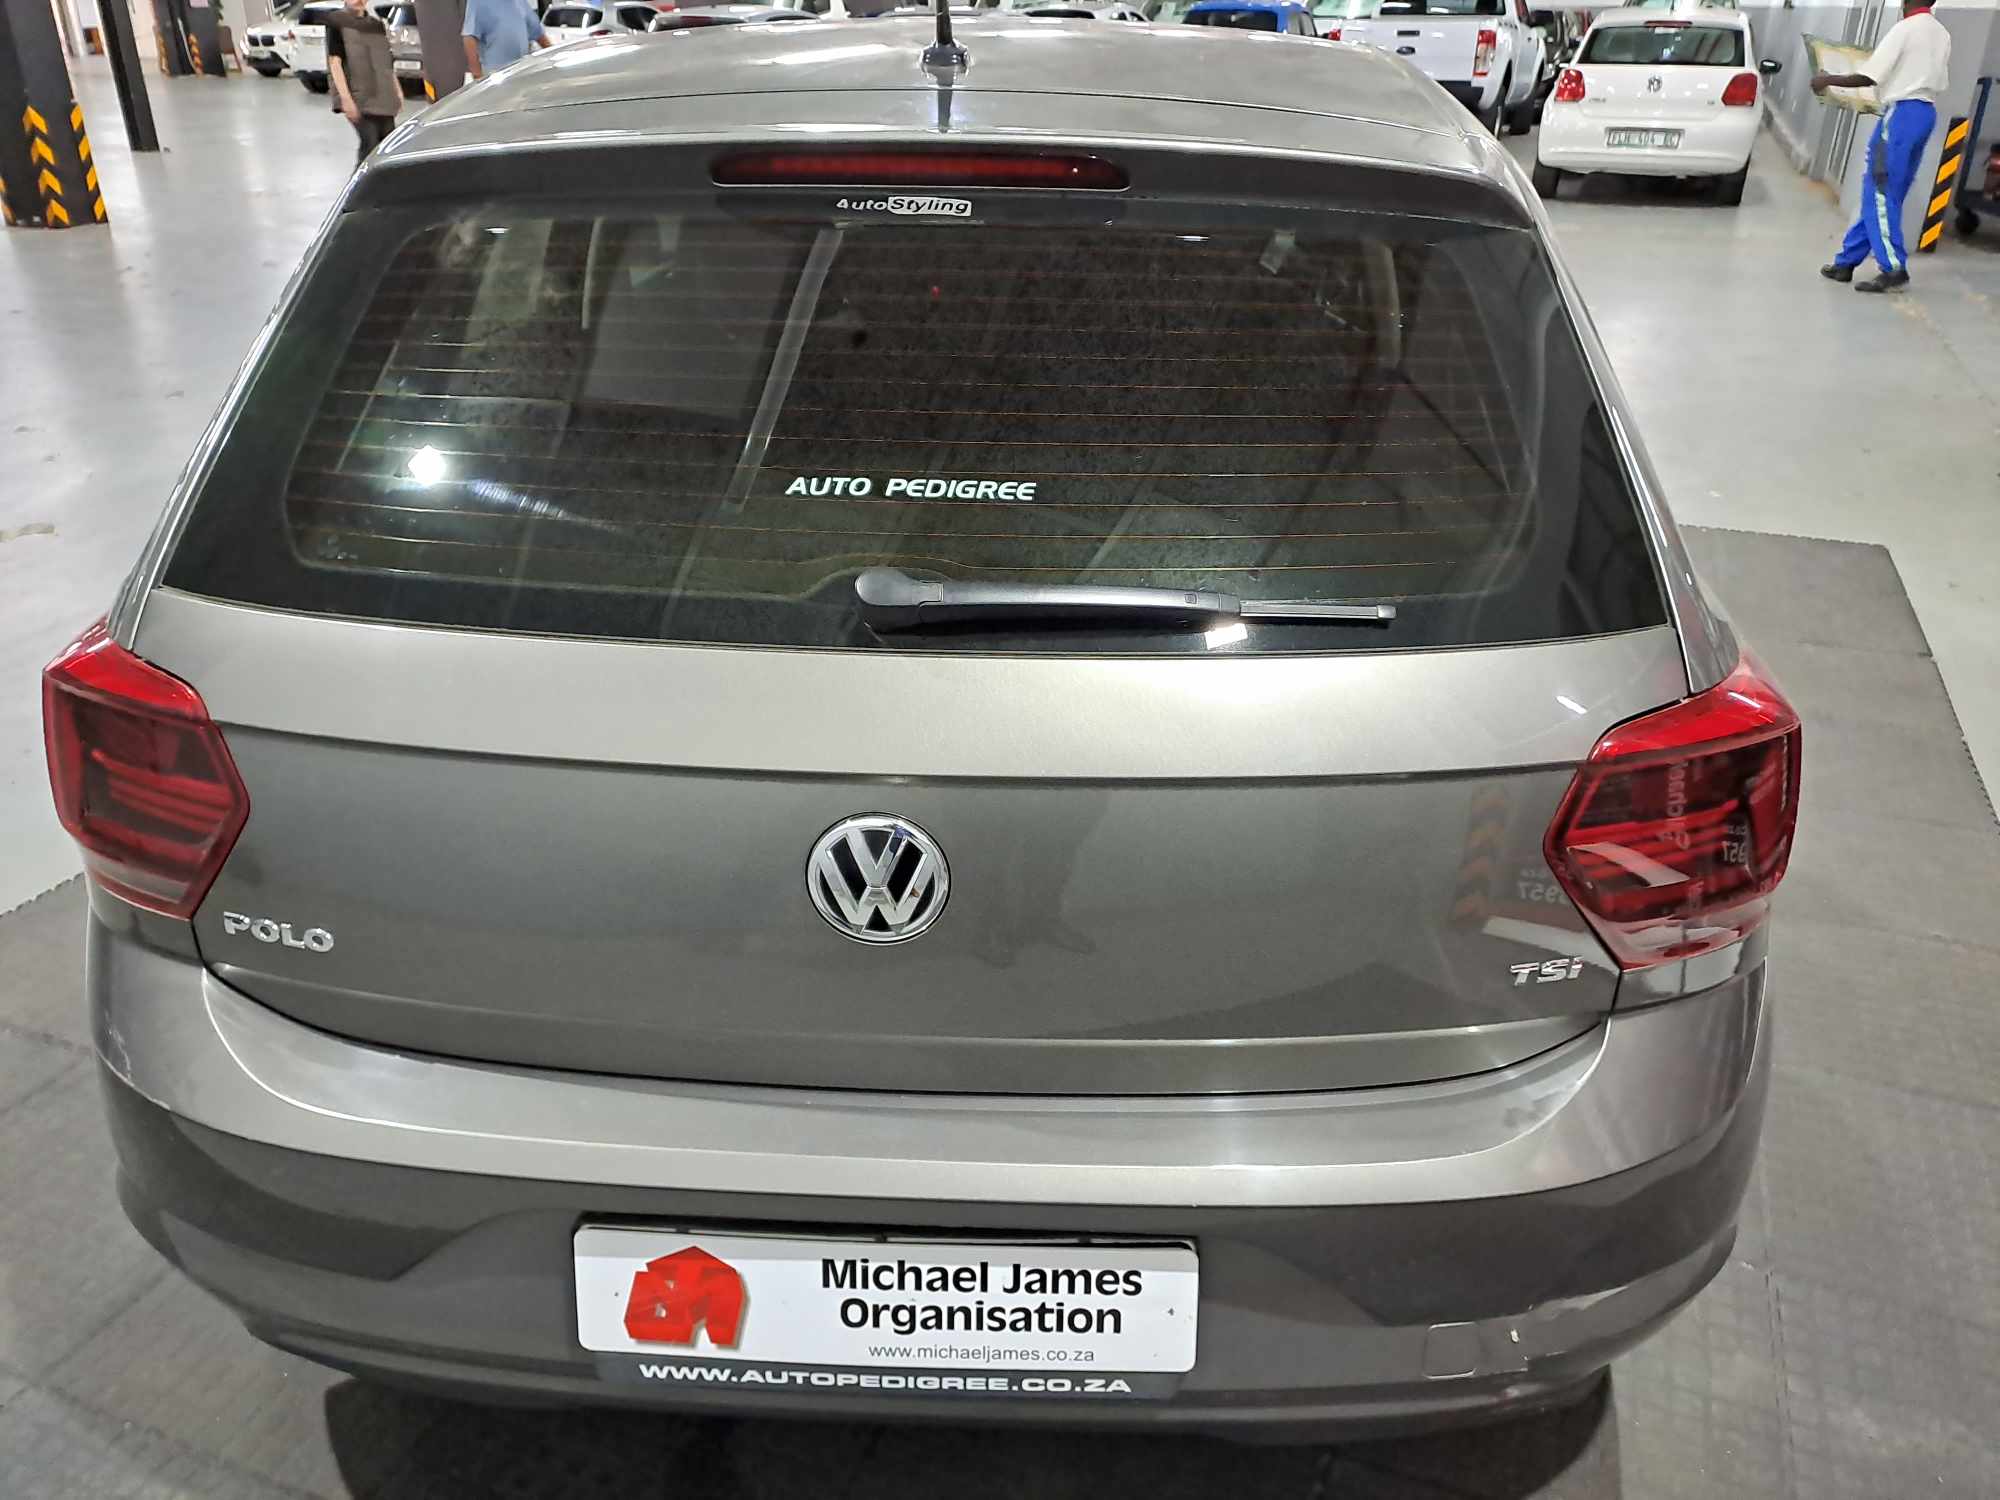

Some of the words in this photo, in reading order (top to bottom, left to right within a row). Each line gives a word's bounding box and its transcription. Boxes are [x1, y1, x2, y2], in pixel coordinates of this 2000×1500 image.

[785, 477, 872, 496] AUTO
[885, 478, 1037, 500] PEDIGREE
[223, 911, 335, 953] POLO
[821, 1258, 989, 1294] Michael
[1002, 1262, 1143, 1297] James
[840, 1297, 1122, 1336] Organisation
[868, 1344, 1095, 1364] www.michaeljames.co.za
[638, 1363, 1132, 1394] WWW.AUTOPEDIGREE.CO.ZA
